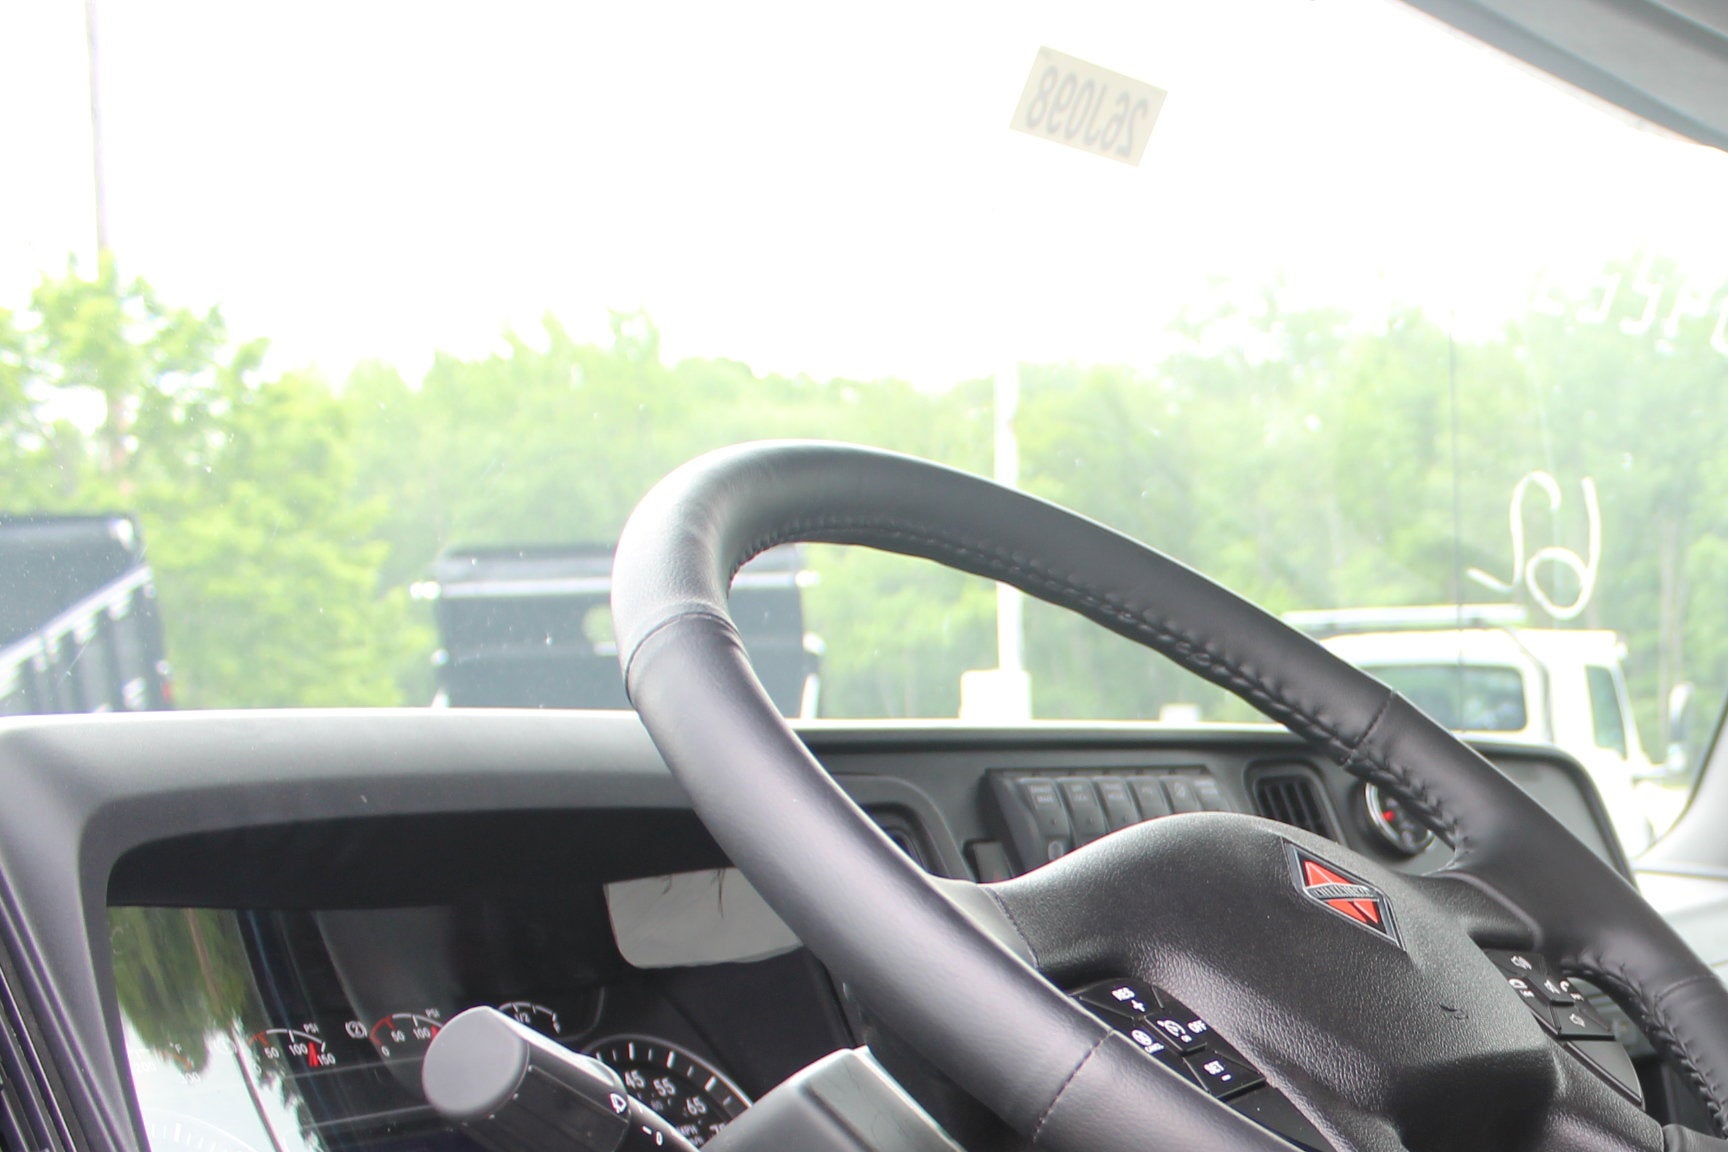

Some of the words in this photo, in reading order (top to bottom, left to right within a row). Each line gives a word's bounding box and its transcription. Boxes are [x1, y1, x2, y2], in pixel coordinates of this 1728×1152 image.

[303, 1022, 319, 1034] PSI
[412, 1027, 432, 1041] 100
[391, 1030, 406, 1043] 50
[263, 1047, 281, 1060] 50
[288, 1043, 309, 1056] 100
[317, 1053, 337, 1066] 150
[624, 1069, 647, 1089] 45
[653, 1076, 677, 1097] 55
[686, 1096, 708, 1116] 65
